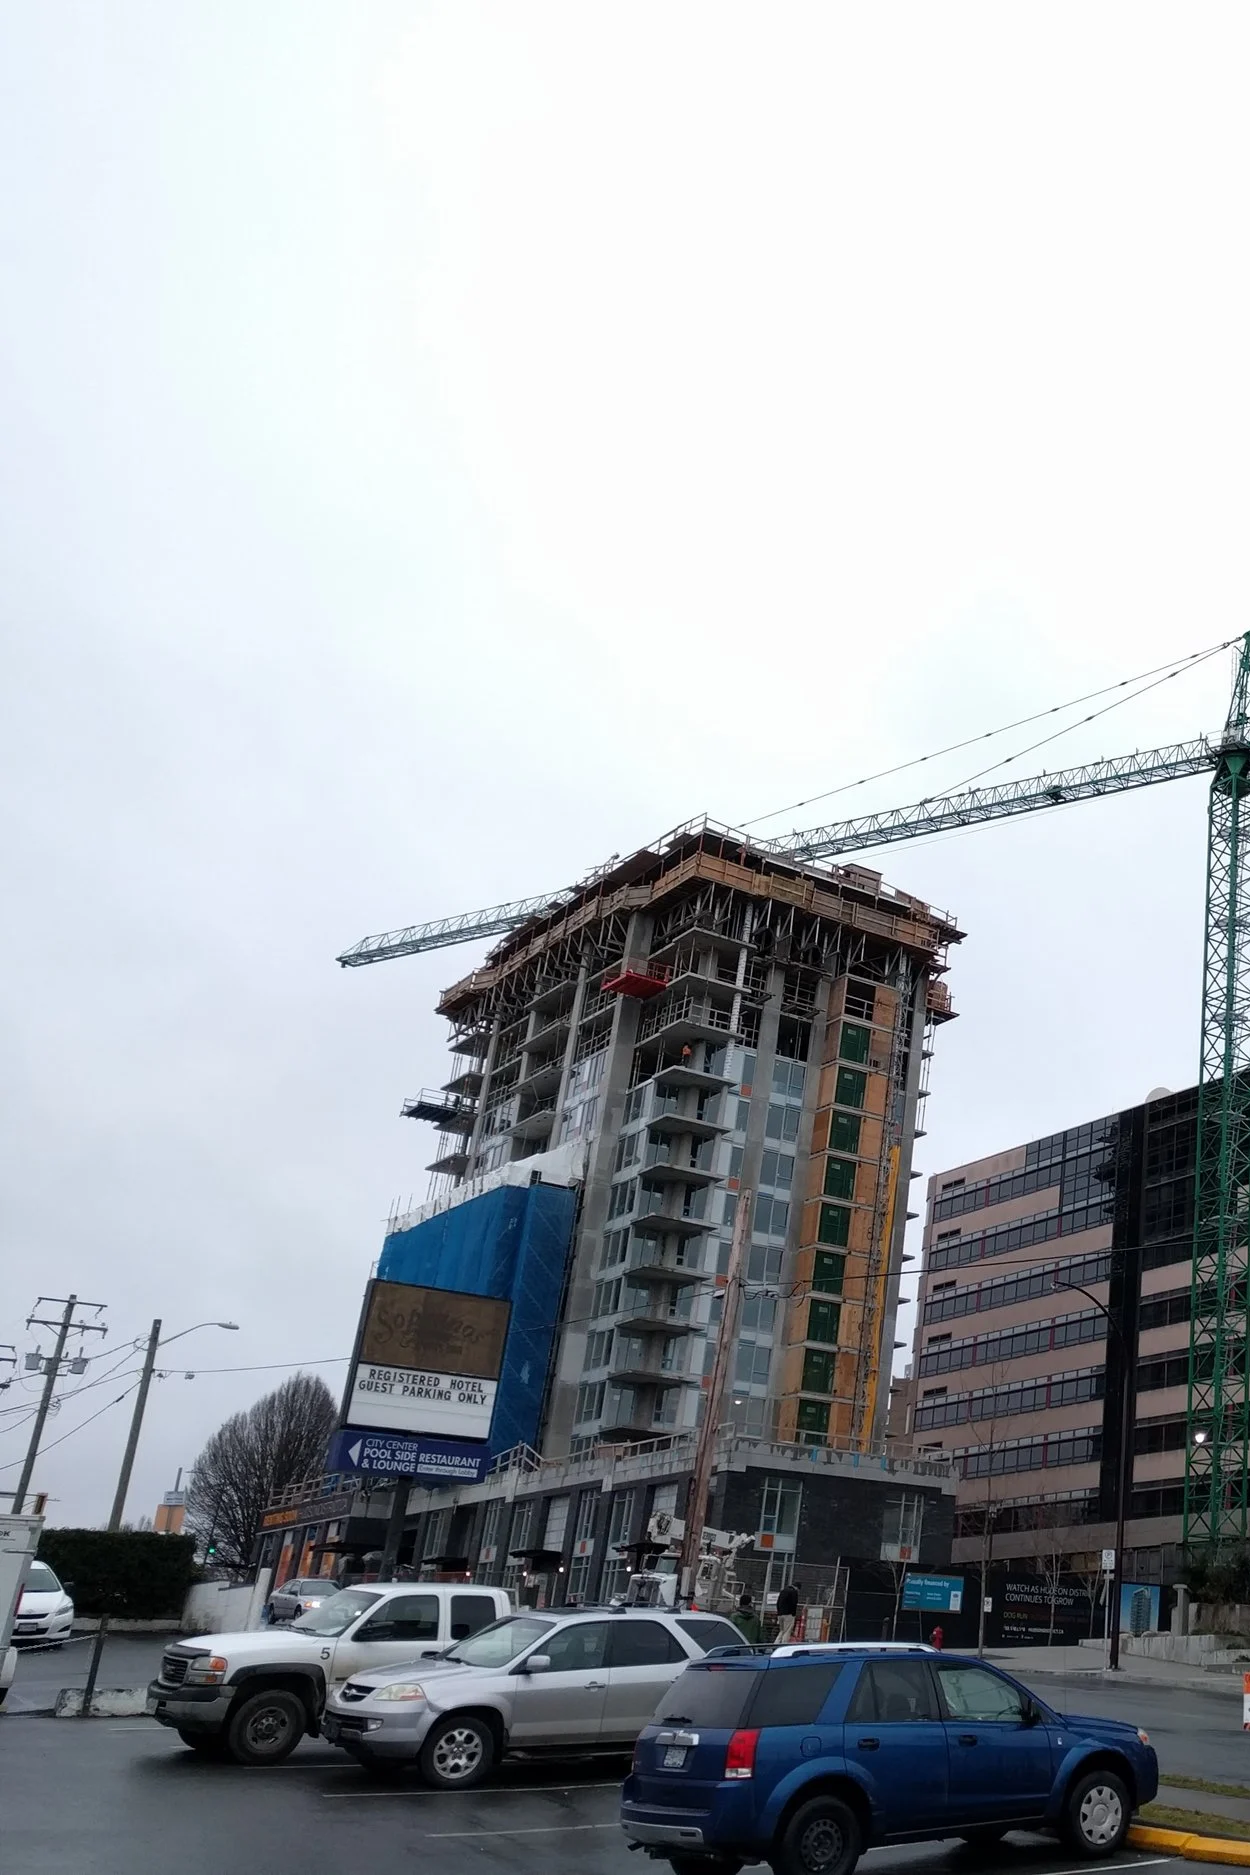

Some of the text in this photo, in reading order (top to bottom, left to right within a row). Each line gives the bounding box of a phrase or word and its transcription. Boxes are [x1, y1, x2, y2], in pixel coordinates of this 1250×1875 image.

[368, 1368, 484, 1393] REGISTERED HOTEL
[358, 1380, 487, 1405] GUEST PARKING ONLY
[365, 1438, 419, 1451] CITY CENTER
[363, 1447, 481, 1467] POOL SIDE RESTAURANT
[361, 1459, 416, 1472] & LOUNGE
[1005, 1583, 1030, 1593] WATCH
[1030, 1586, 1039, 1594] AS
[1005, 1593, 1043, 1604] CONTINUES
[1053, 1597, 1074, 1605] GROW
[320, 1647, 331, 1660] 5
